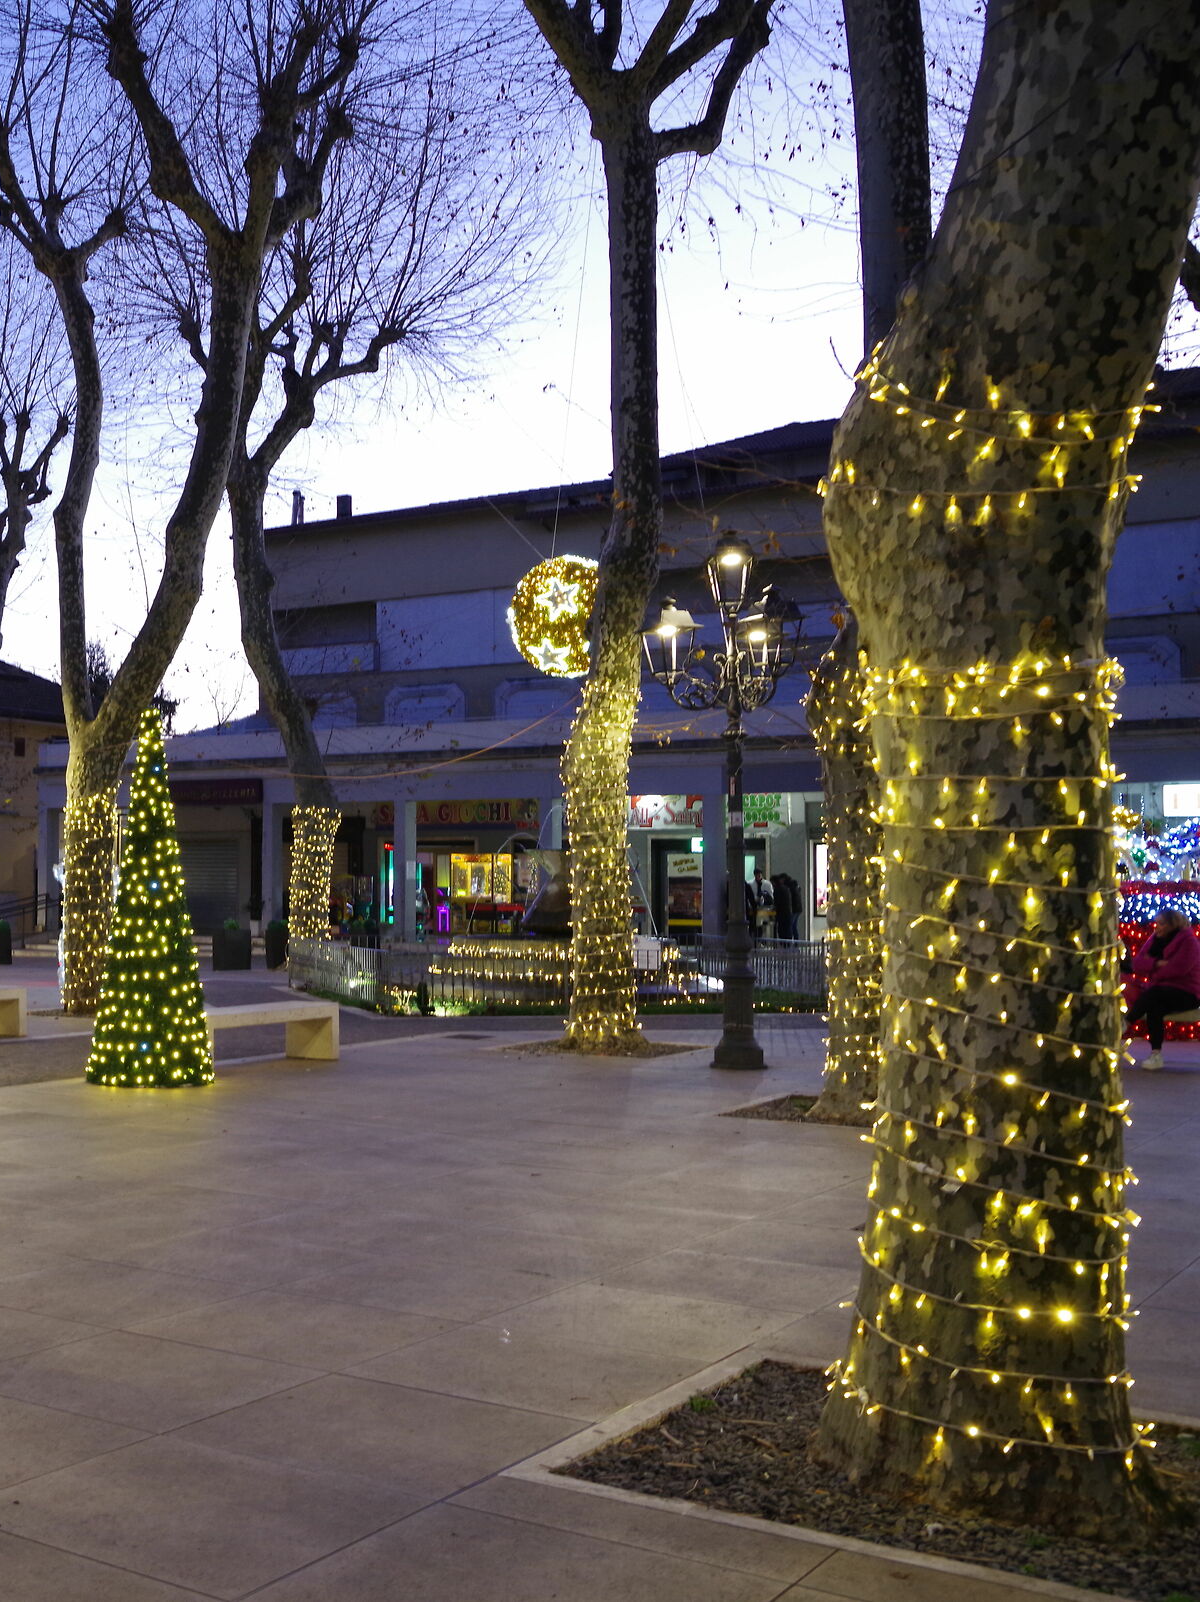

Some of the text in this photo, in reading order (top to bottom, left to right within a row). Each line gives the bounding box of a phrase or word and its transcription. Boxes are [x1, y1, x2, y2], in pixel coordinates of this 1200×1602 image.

[743, 793, 781, 807] CKPOT
[378, 802, 512, 823] SA GIOCHI
